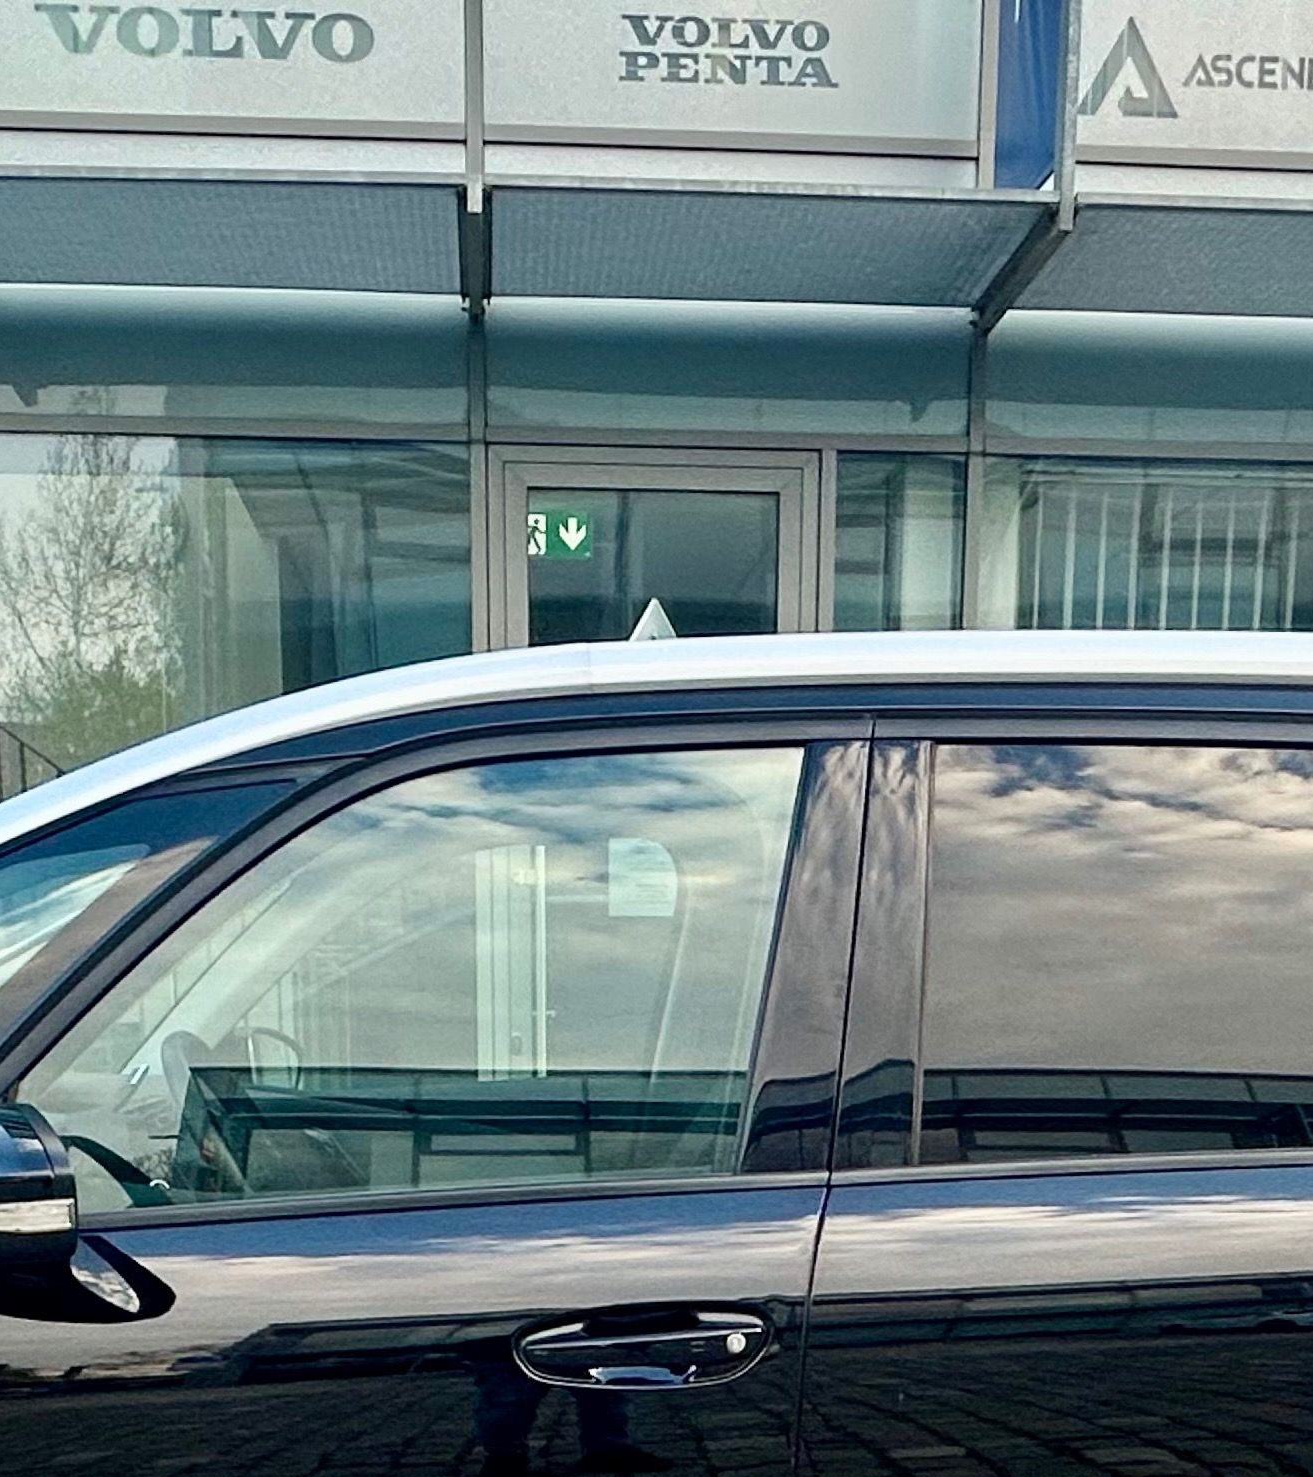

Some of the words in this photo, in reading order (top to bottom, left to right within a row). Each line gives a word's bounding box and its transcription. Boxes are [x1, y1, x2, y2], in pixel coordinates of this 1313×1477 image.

[34, 4, 375, 63] VOLVO
[621, 14, 830, 51] VOLVO
[618, 51, 839, 88] PENTA
